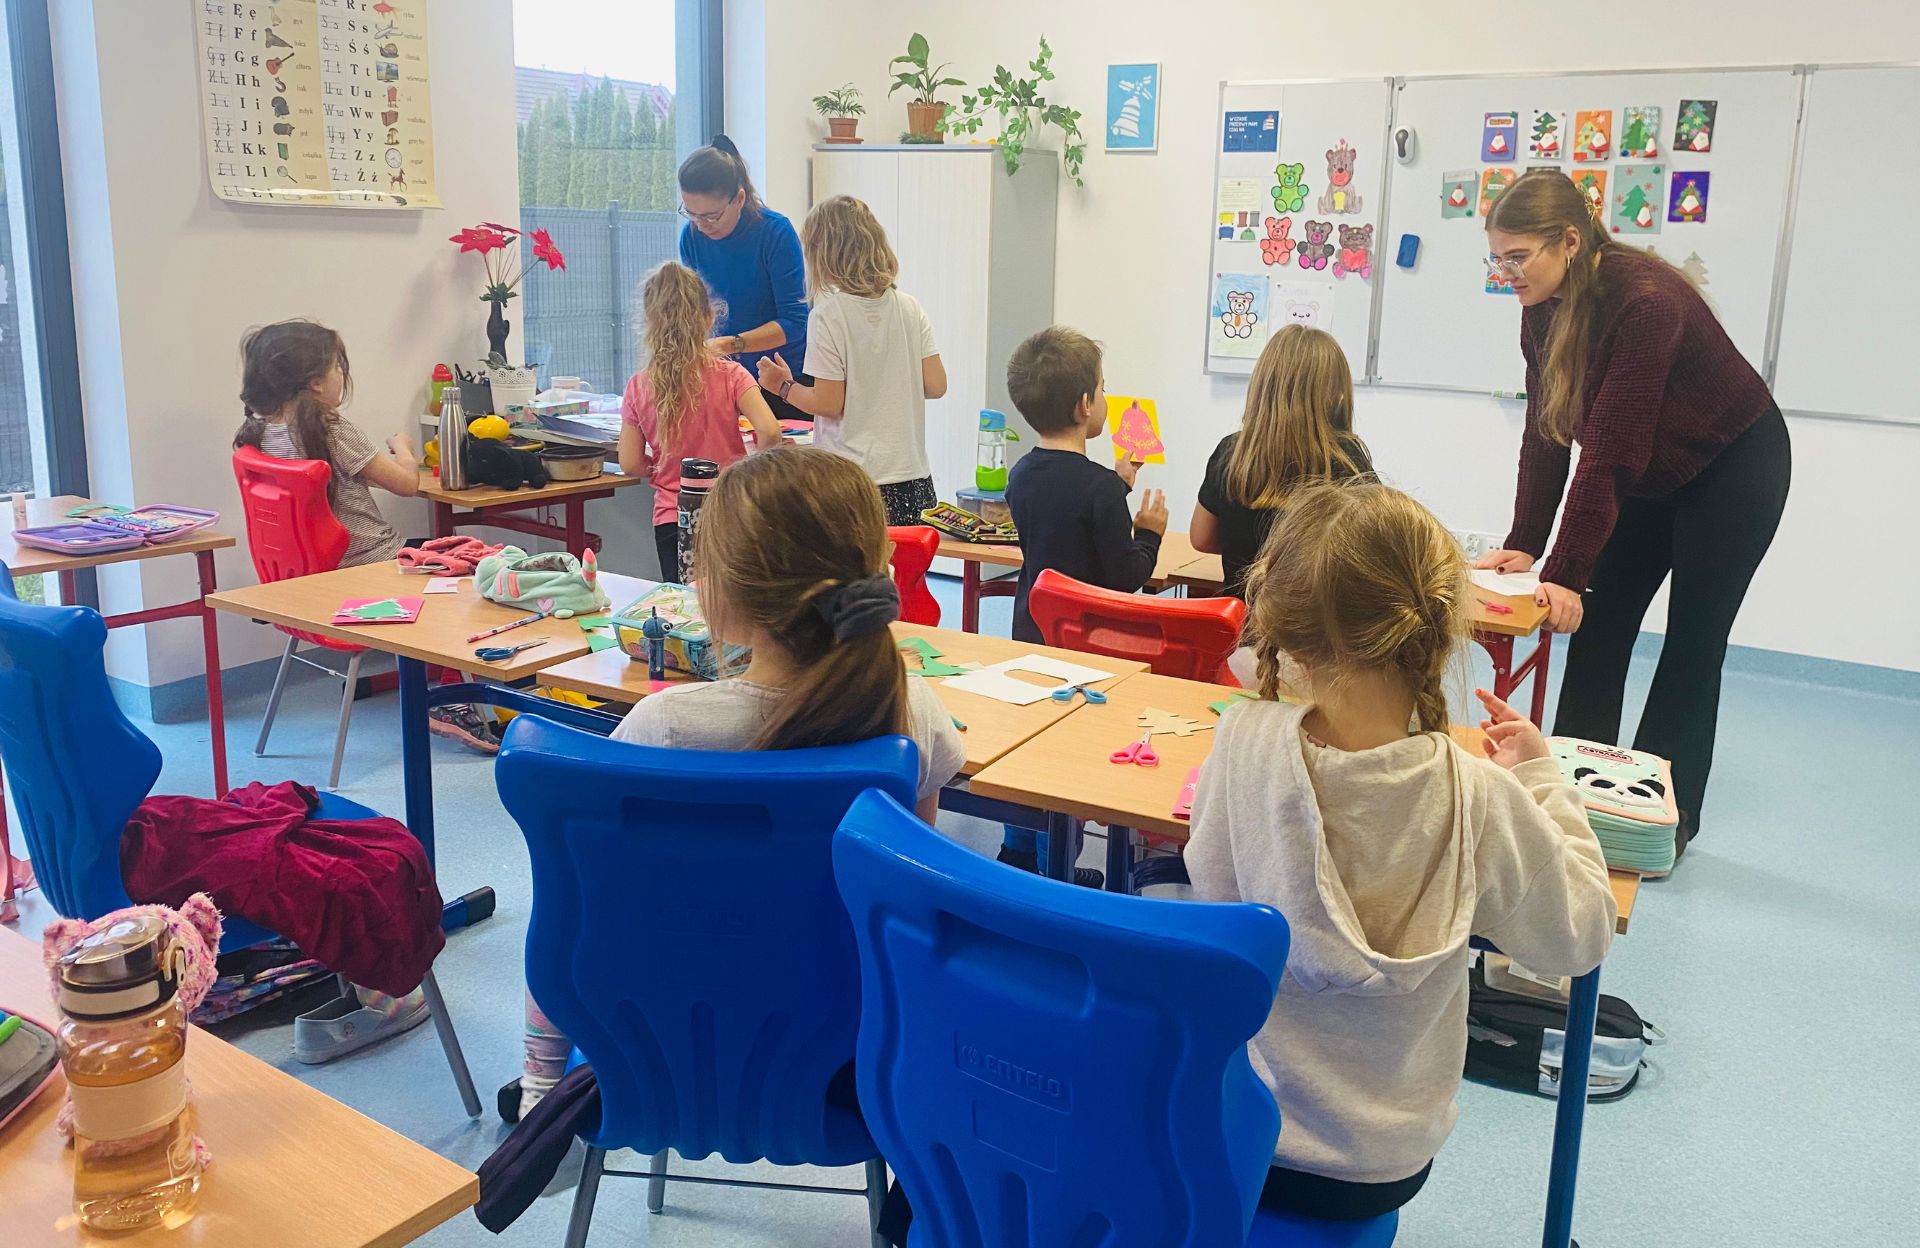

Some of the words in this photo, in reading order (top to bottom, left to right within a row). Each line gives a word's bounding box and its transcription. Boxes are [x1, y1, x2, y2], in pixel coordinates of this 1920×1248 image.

[234, 3, 243, 19] Ę
[249, 9, 257, 21] ę
[346, 0, 356, 10] R
[361, 3, 367, 12] r
[234, 26, 244, 39] F
[251, 29, 257, 41] f
[348, 19, 356, 31] S
[362, 24, 369, 34] s
[348, 38, 357, 54] Ś
[363, 43, 370, 56] ś
[234, 50, 245, 63] G
[251, 54, 260, 67] g
[349, 63, 359, 75] T
[365, 67, 371, 77] t
[235, 73, 246, 86] H
[251, 75, 261, 88] h
[350, 85, 360, 97] U
[364, 90, 372, 98] u
[240, 96, 246, 109] I
[255, 98, 260, 110] i
[349, 106, 362, 119] W
[364, 111, 374, 120] w
[241, 119, 248, 132] J
[257, 120, 262, 135] j
[353, 128, 362, 140] Y
[367, 132, 374, 143] y
[242, 142, 254, 155] K
[257, 143, 267, 156] k
[354, 149, 363, 161] Z
[369, 153, 376, 162] z
[245, 165, 256, 177] L
